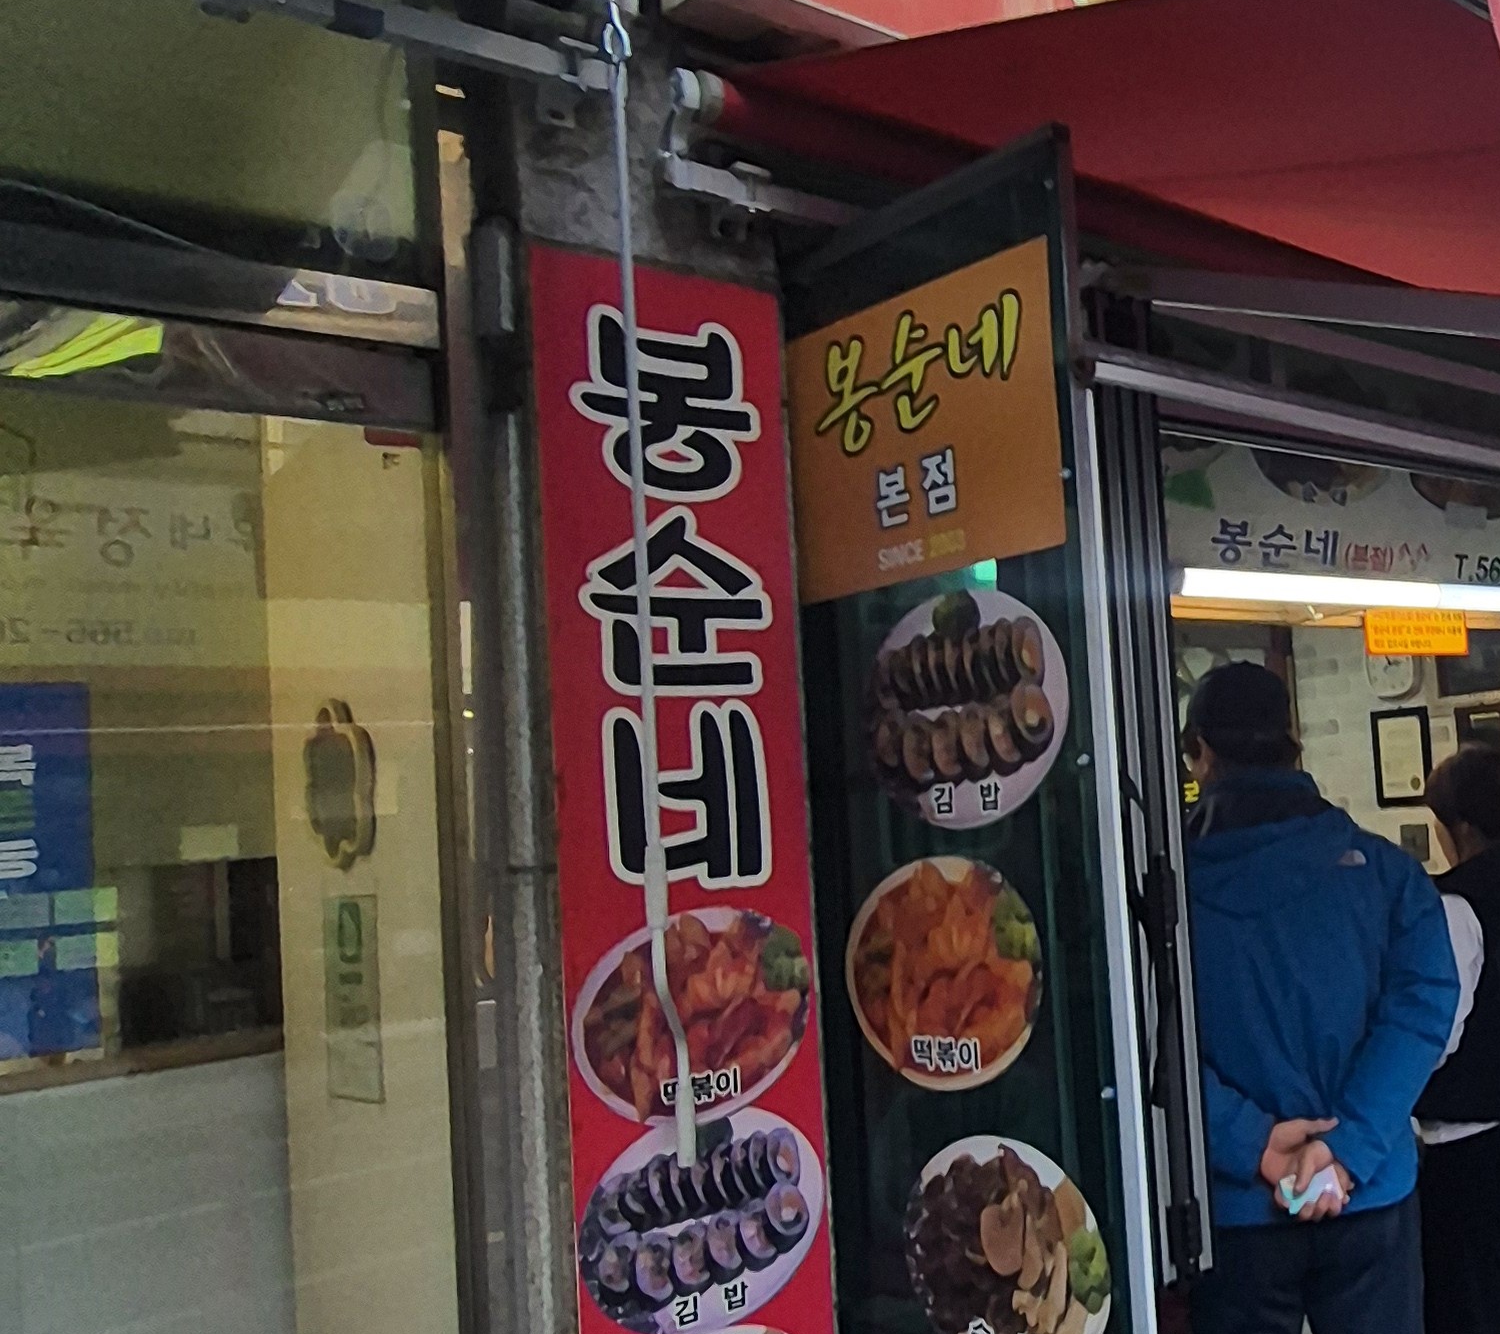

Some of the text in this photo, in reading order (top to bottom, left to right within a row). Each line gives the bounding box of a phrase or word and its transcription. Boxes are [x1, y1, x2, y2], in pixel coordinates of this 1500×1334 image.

[815, 288, 1021, 454] 봉순네
[876, 445, 958, 528] 본점
[1211, 517, 1340, 567] 봉순네
[570, 304, 772, 890] 봉순네
[932, 781, 1002, 816] 김밥
[912, 1036, 982, 1073] 떡볶이
[674, 1281, 749, 1328] 김밥
